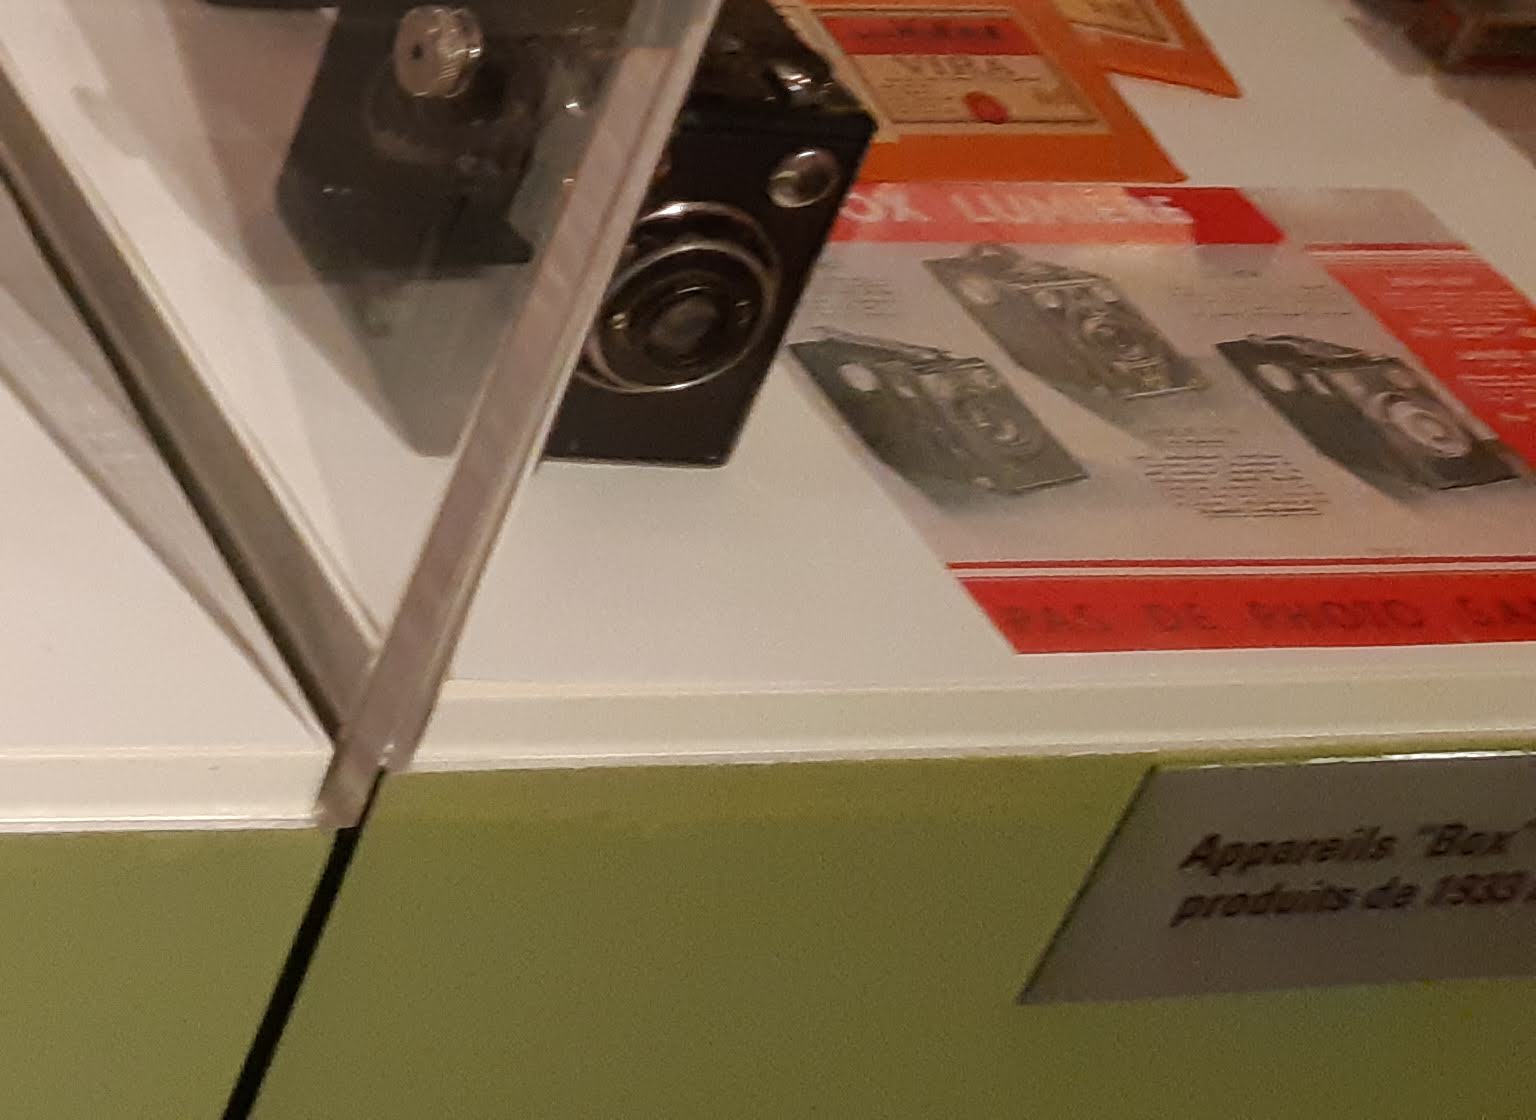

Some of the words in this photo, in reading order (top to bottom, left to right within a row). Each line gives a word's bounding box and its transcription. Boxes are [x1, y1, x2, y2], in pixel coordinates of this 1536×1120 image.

[1178, 826, 1398, 877] Appareils
[1168, 880, 1357, 929] produits
[1360, 876, 1421, 912] de
